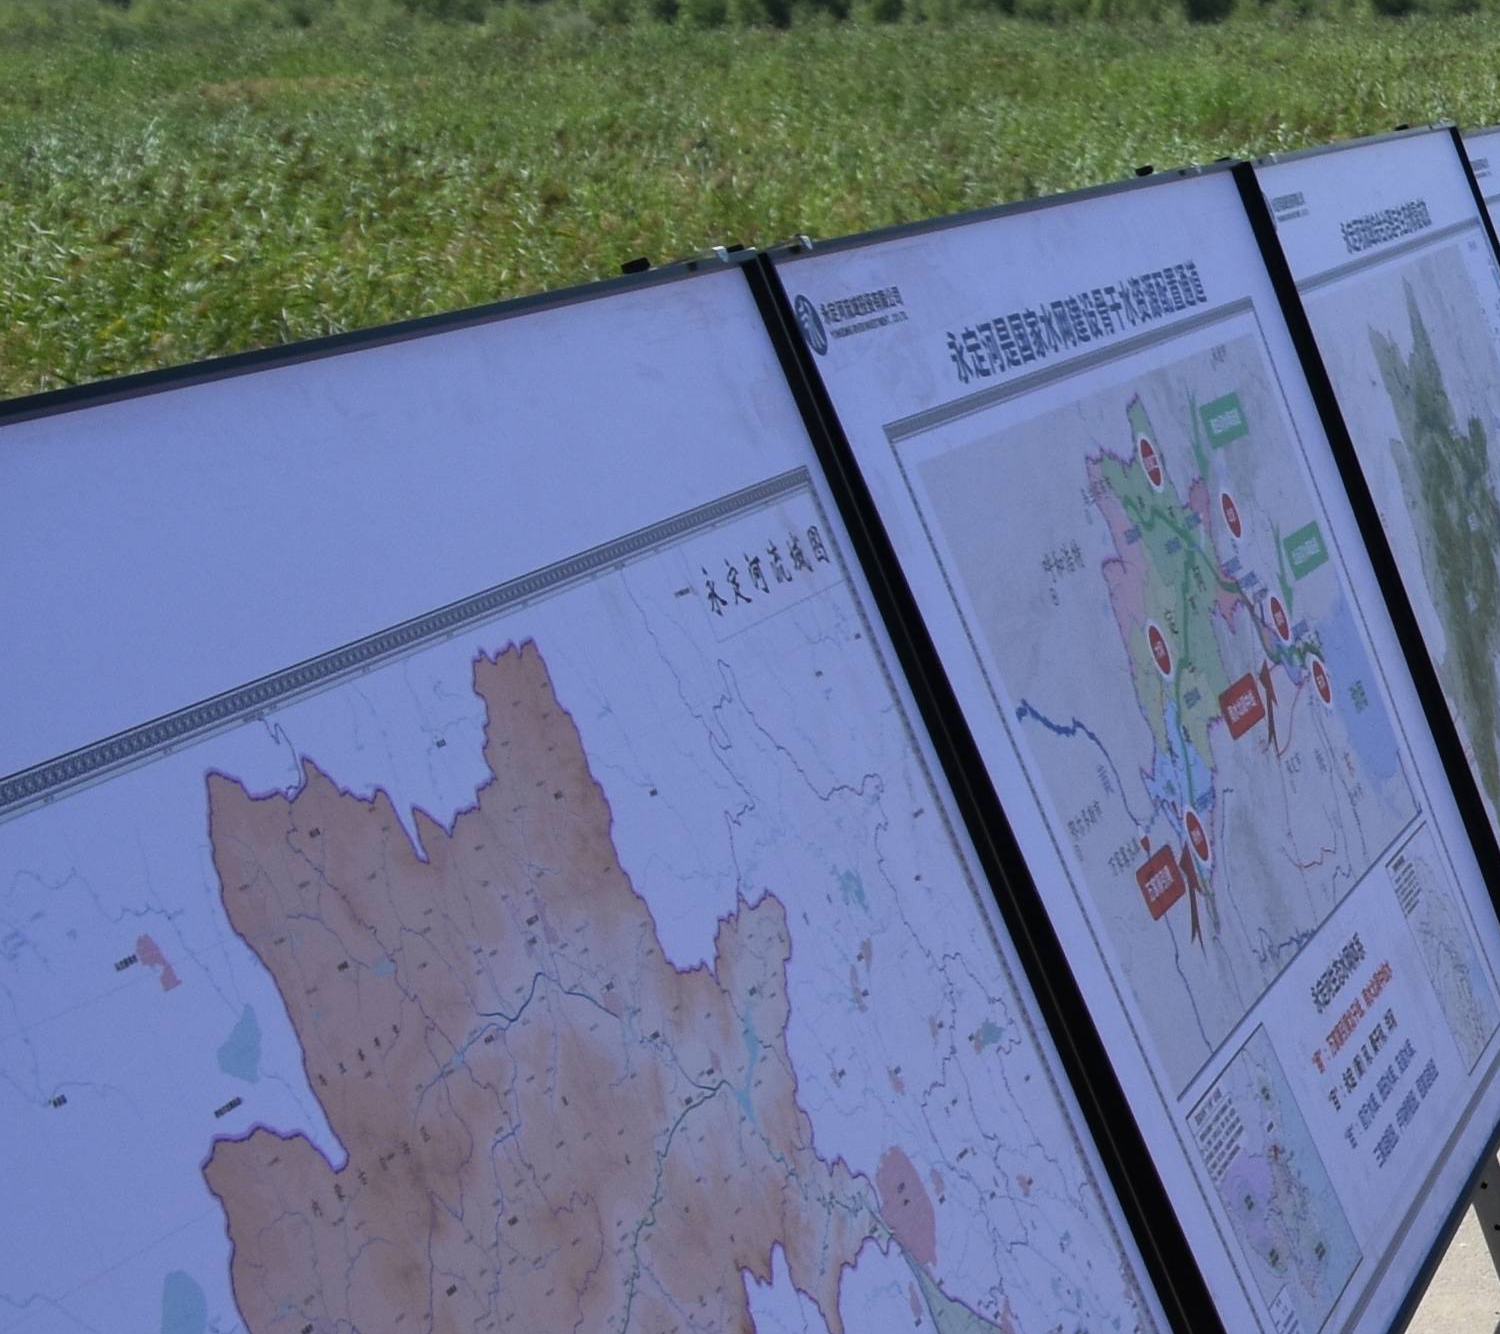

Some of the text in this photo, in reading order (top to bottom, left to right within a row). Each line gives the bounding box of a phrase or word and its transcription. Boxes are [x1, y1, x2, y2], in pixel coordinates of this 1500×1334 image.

[701, 525, 831, 617] 永定河流域图
